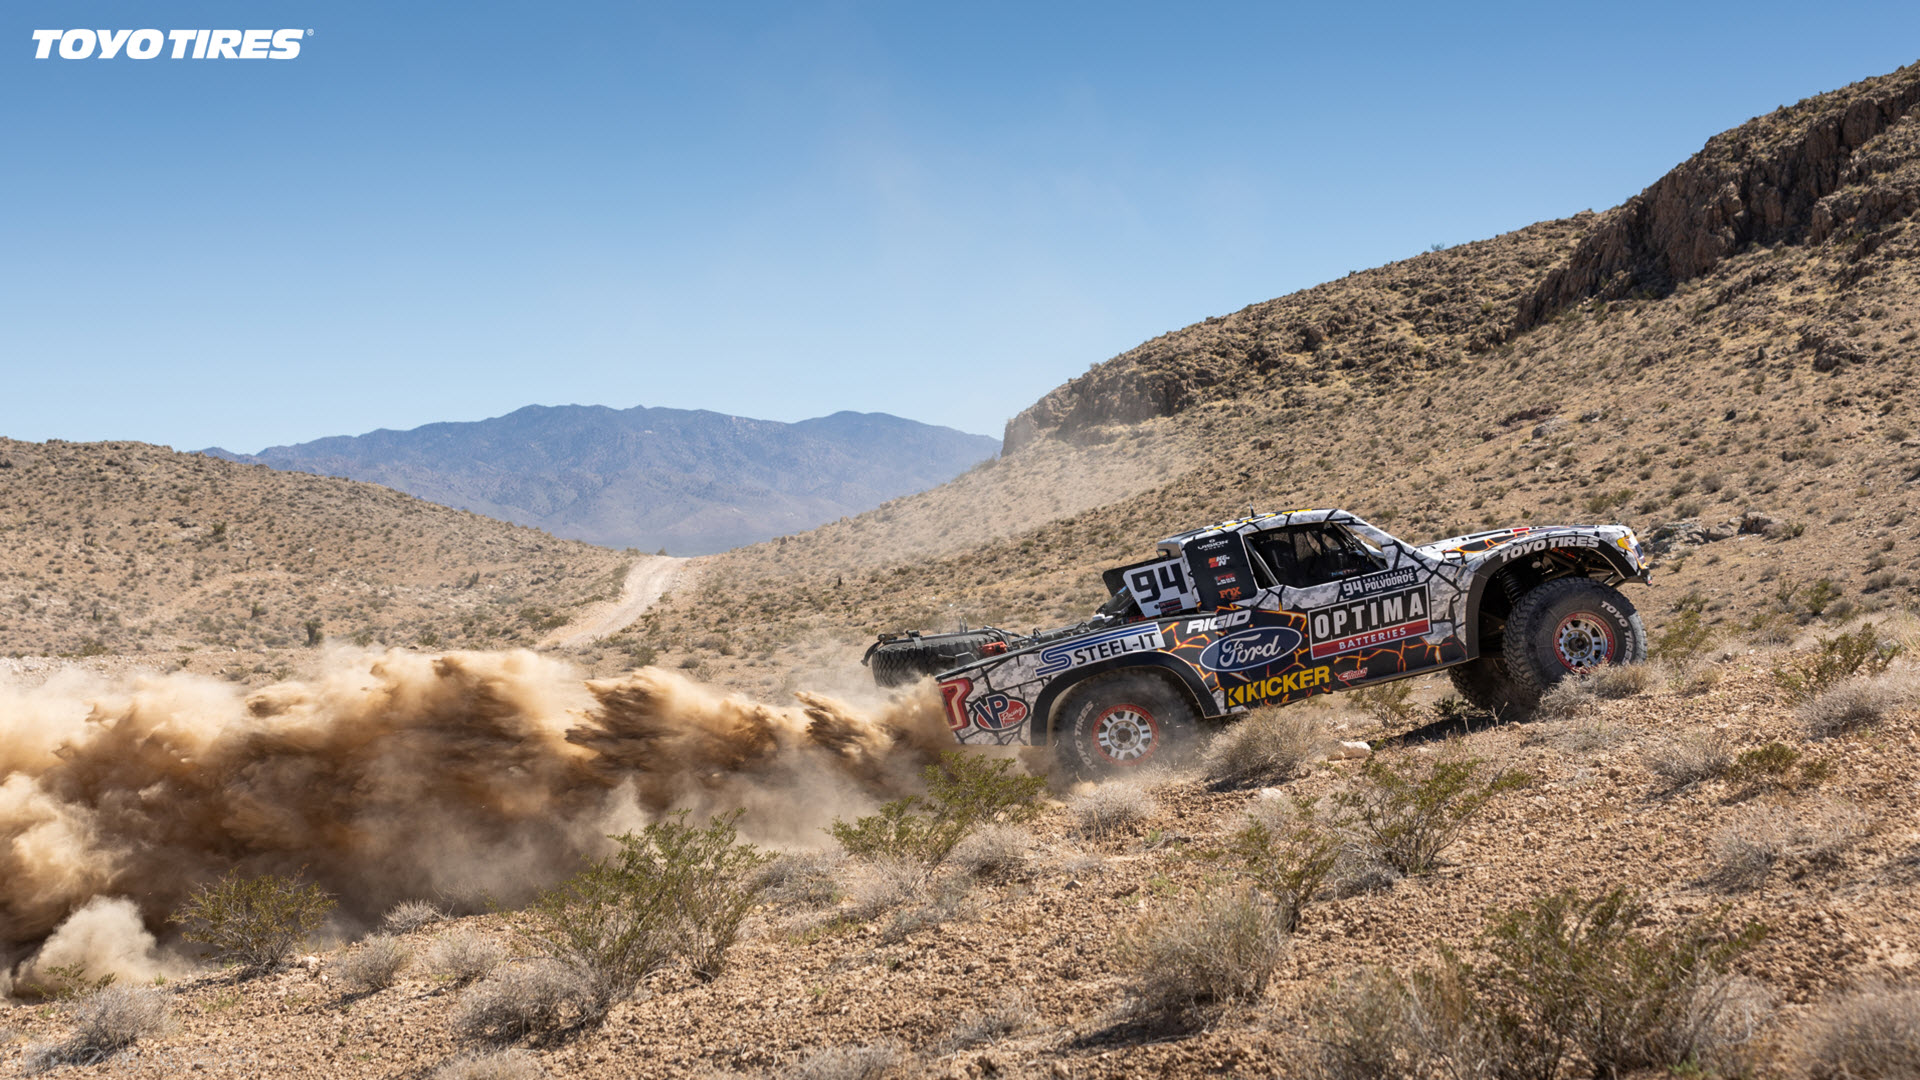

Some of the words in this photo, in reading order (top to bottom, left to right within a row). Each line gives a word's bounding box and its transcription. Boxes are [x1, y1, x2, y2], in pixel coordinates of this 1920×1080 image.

[1500, 539, 1547, 563] TOYO
[1548, 536, 1600, 550] TIRES
[1131, 562, 1188, 604] 94
[1219, 587, 1242, 600] FOX
[1343, 580, 1364, 597] 94
[1364, 572, 1415, 592] POLVOORDE
[1186, 610, 1251, 634] RIGID
[1314, 592, 1424, 639] OPTIMA
[1600, 601, 1628, 628] TOYO
[1074, 633, 1157, 665] STEEL-IT
[1219, 633, 1281, 668] Ford
[1339, 627, 1406, 650] BATTERIES
[1246, 665, 1330, 702] KICKER
[974, 694, 1008, 729] VP
[1001, 705, 1025, 721] Racing
[1074, 701, 1095, 736] TIRES
